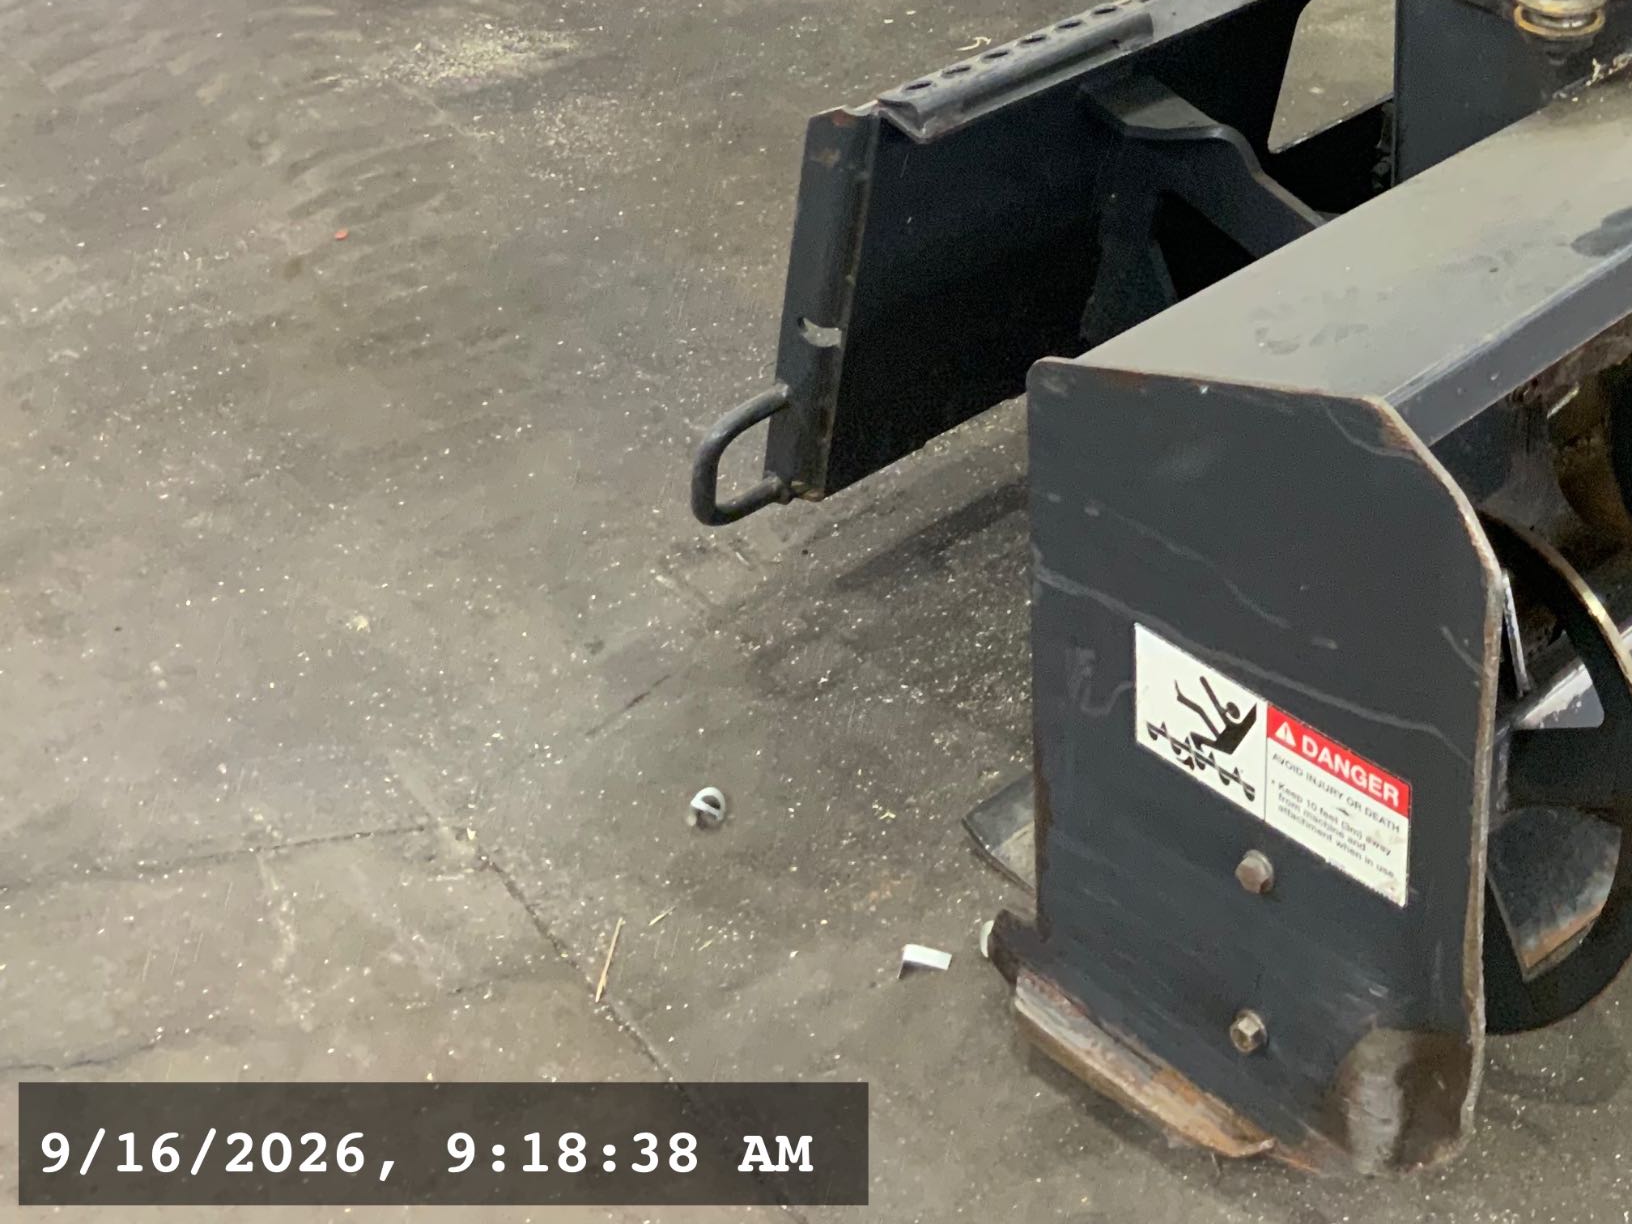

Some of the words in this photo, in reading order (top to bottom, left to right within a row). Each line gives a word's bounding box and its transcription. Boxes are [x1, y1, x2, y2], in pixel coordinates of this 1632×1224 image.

[1272, 753, 1304, 777] AVOID
[1306, 772, 1343, 799] INJURY
[1346, 796, 1363, 812] OR
[1364, 807, 1400, 833] DEATH
[1302, 734, 1400, 808] DANGER
[1306, 798, 1318, 812] 10
[1365, 835, 1392, 857] away
